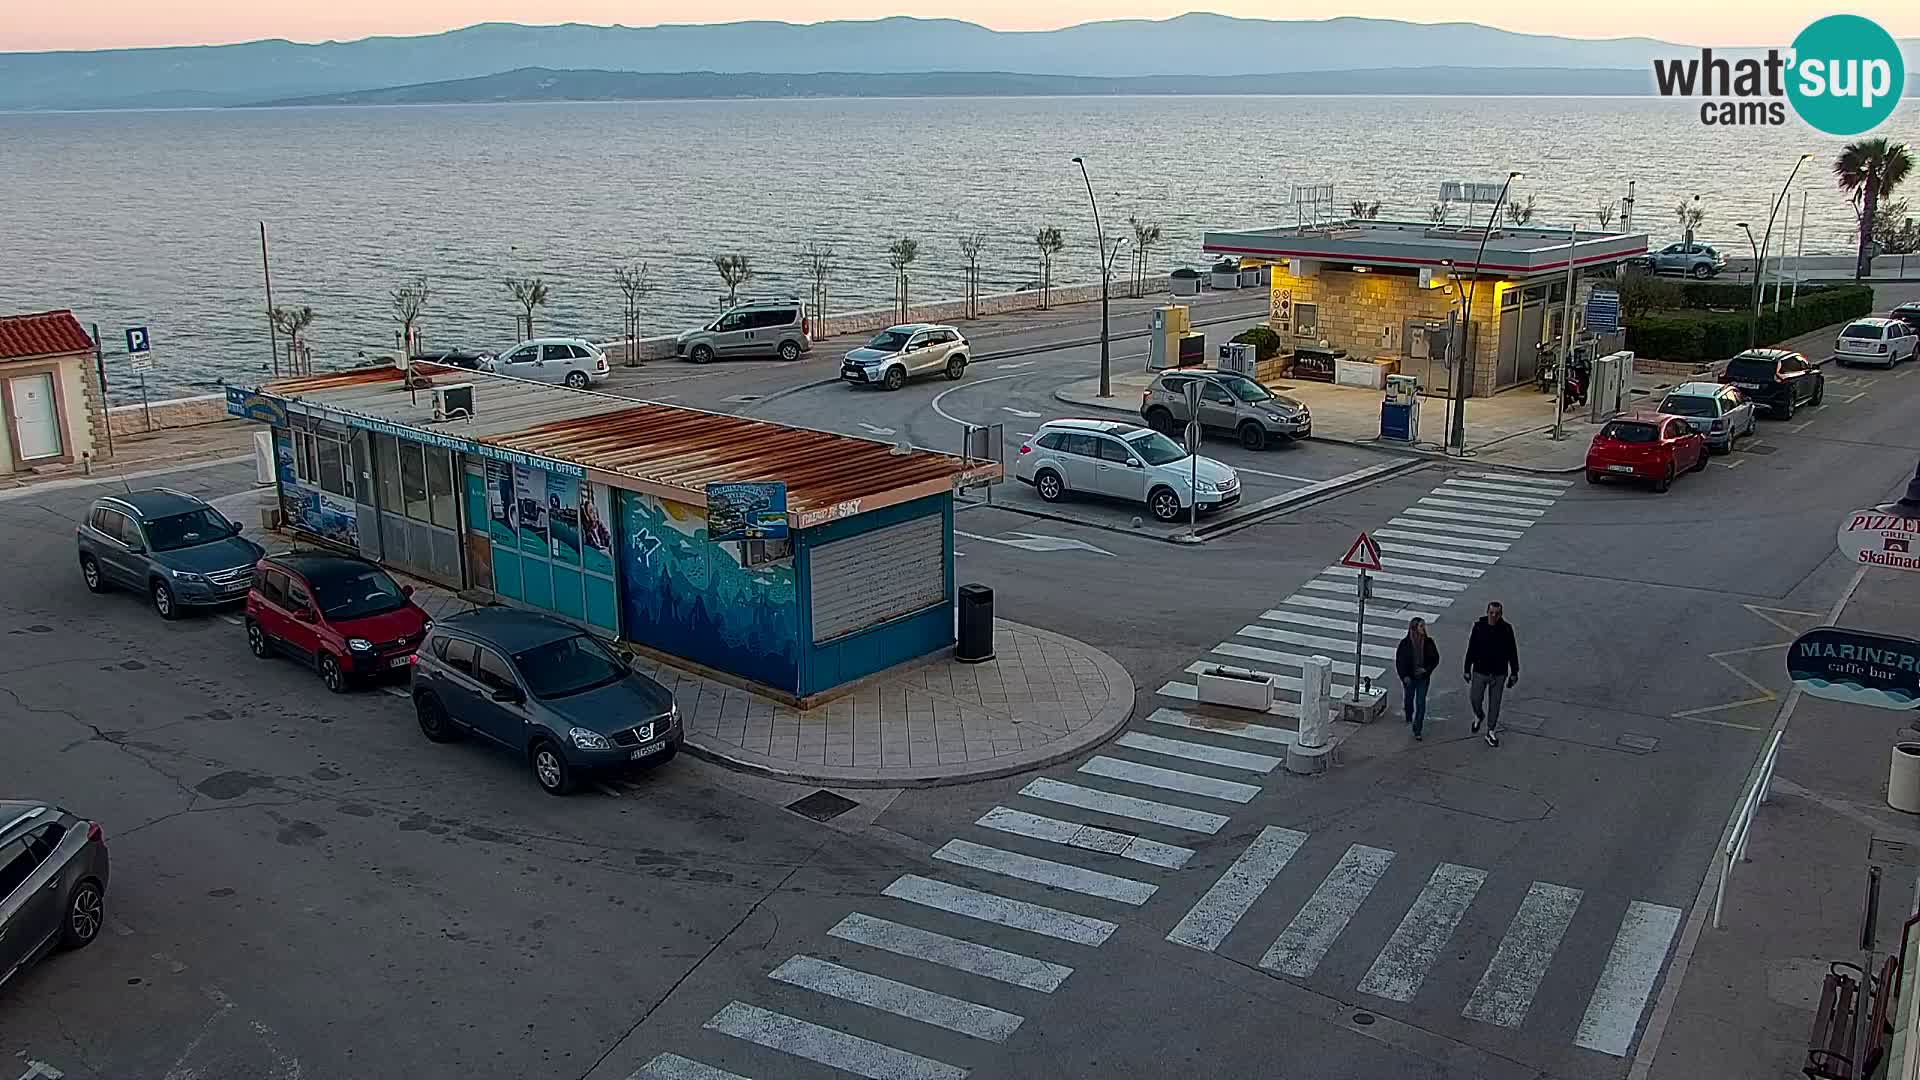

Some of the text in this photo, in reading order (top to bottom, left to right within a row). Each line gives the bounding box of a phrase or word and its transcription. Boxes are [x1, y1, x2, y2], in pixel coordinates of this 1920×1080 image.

[131, 330, 144, 350] P
[437, 436, 469, 453] POSTAJA
[479, 446, 494, 457] BUS
[494, 449, 527, 464] STATION
[528, 457, 555, 471] TICKET
[556, 462, 583, 477] OFFICE
[1880, 530, 1917, 541] GRILL
[1828, 662, 1896, 680] caffe bar
